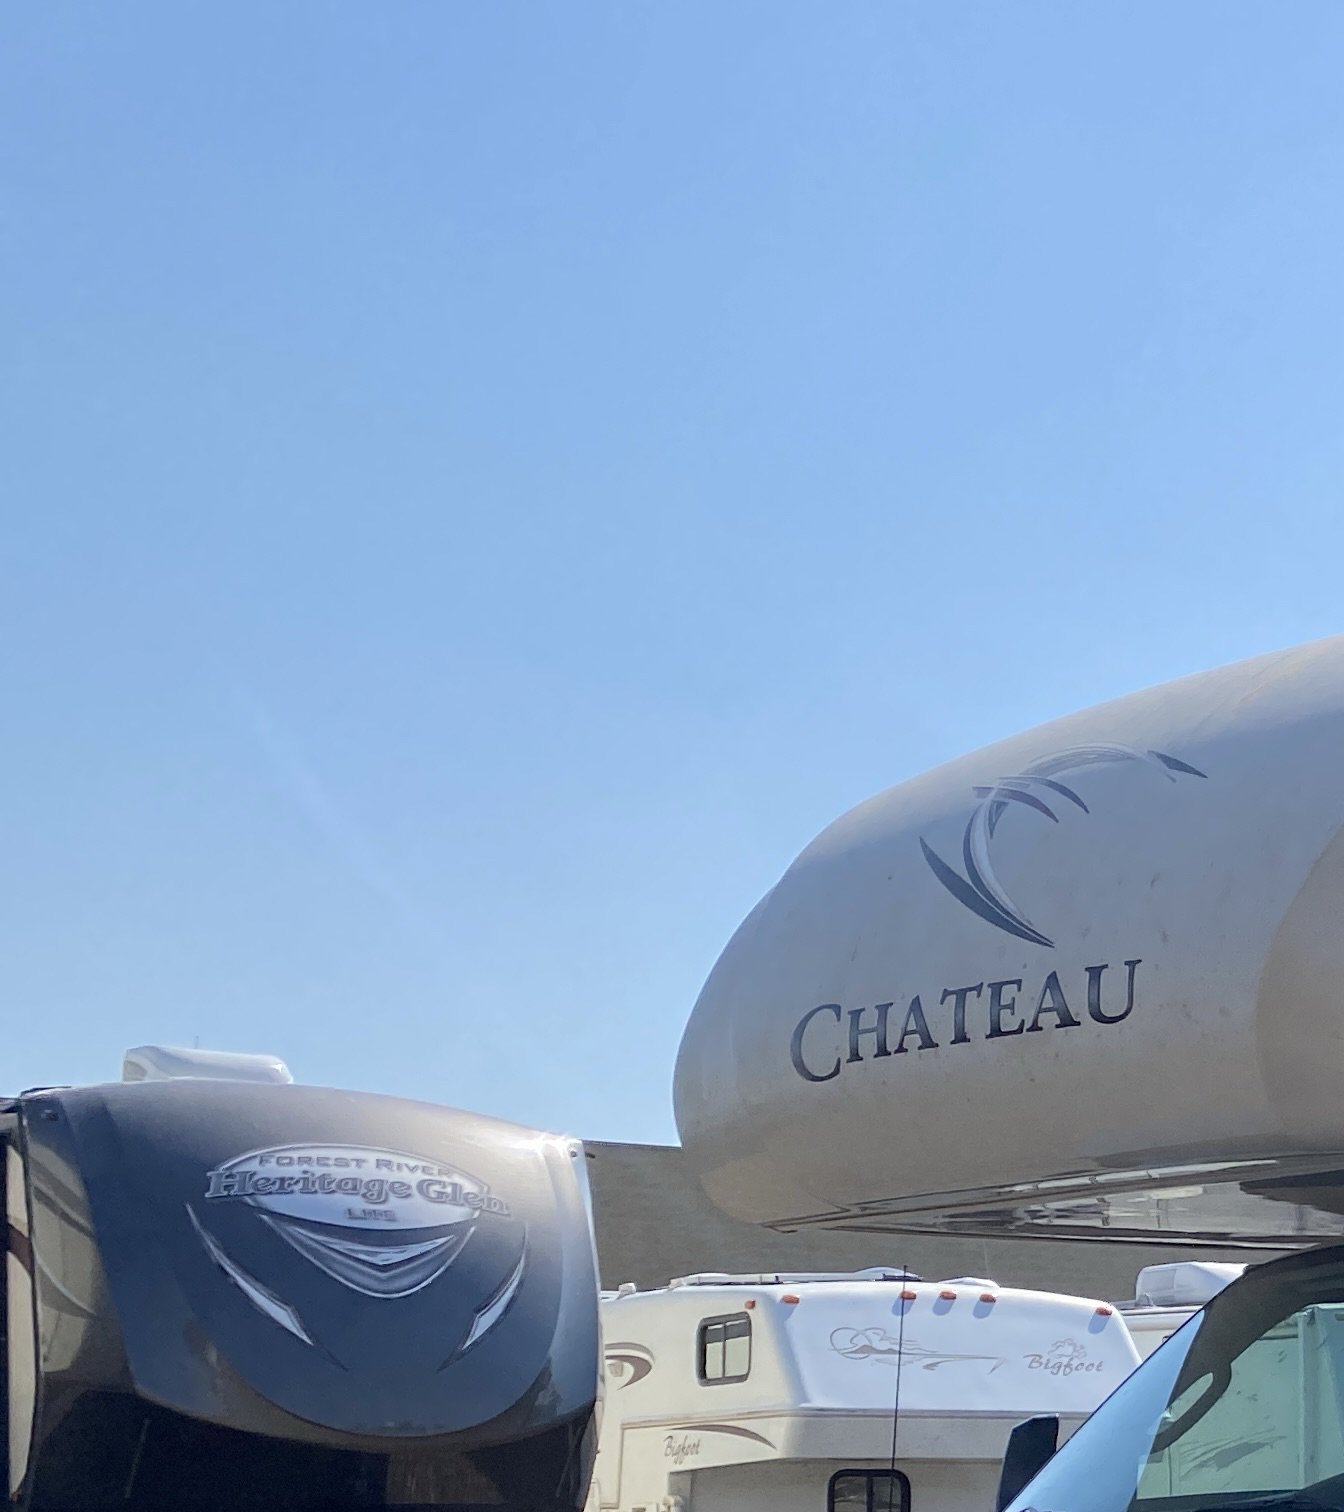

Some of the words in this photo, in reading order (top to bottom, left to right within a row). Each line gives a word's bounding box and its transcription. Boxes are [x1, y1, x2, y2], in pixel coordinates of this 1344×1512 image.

[789, 959, 1142, 1082] CHATEAU
[258, 1154, 368, 1170] FOREST
[205, 1170, 412, 1204] Heritage
[416, 1179, 510, 1216] Glen
[1023, 1353, 1104, 1376] Bigfoot
[664, 1435, 701, 1465] Bigfoot
